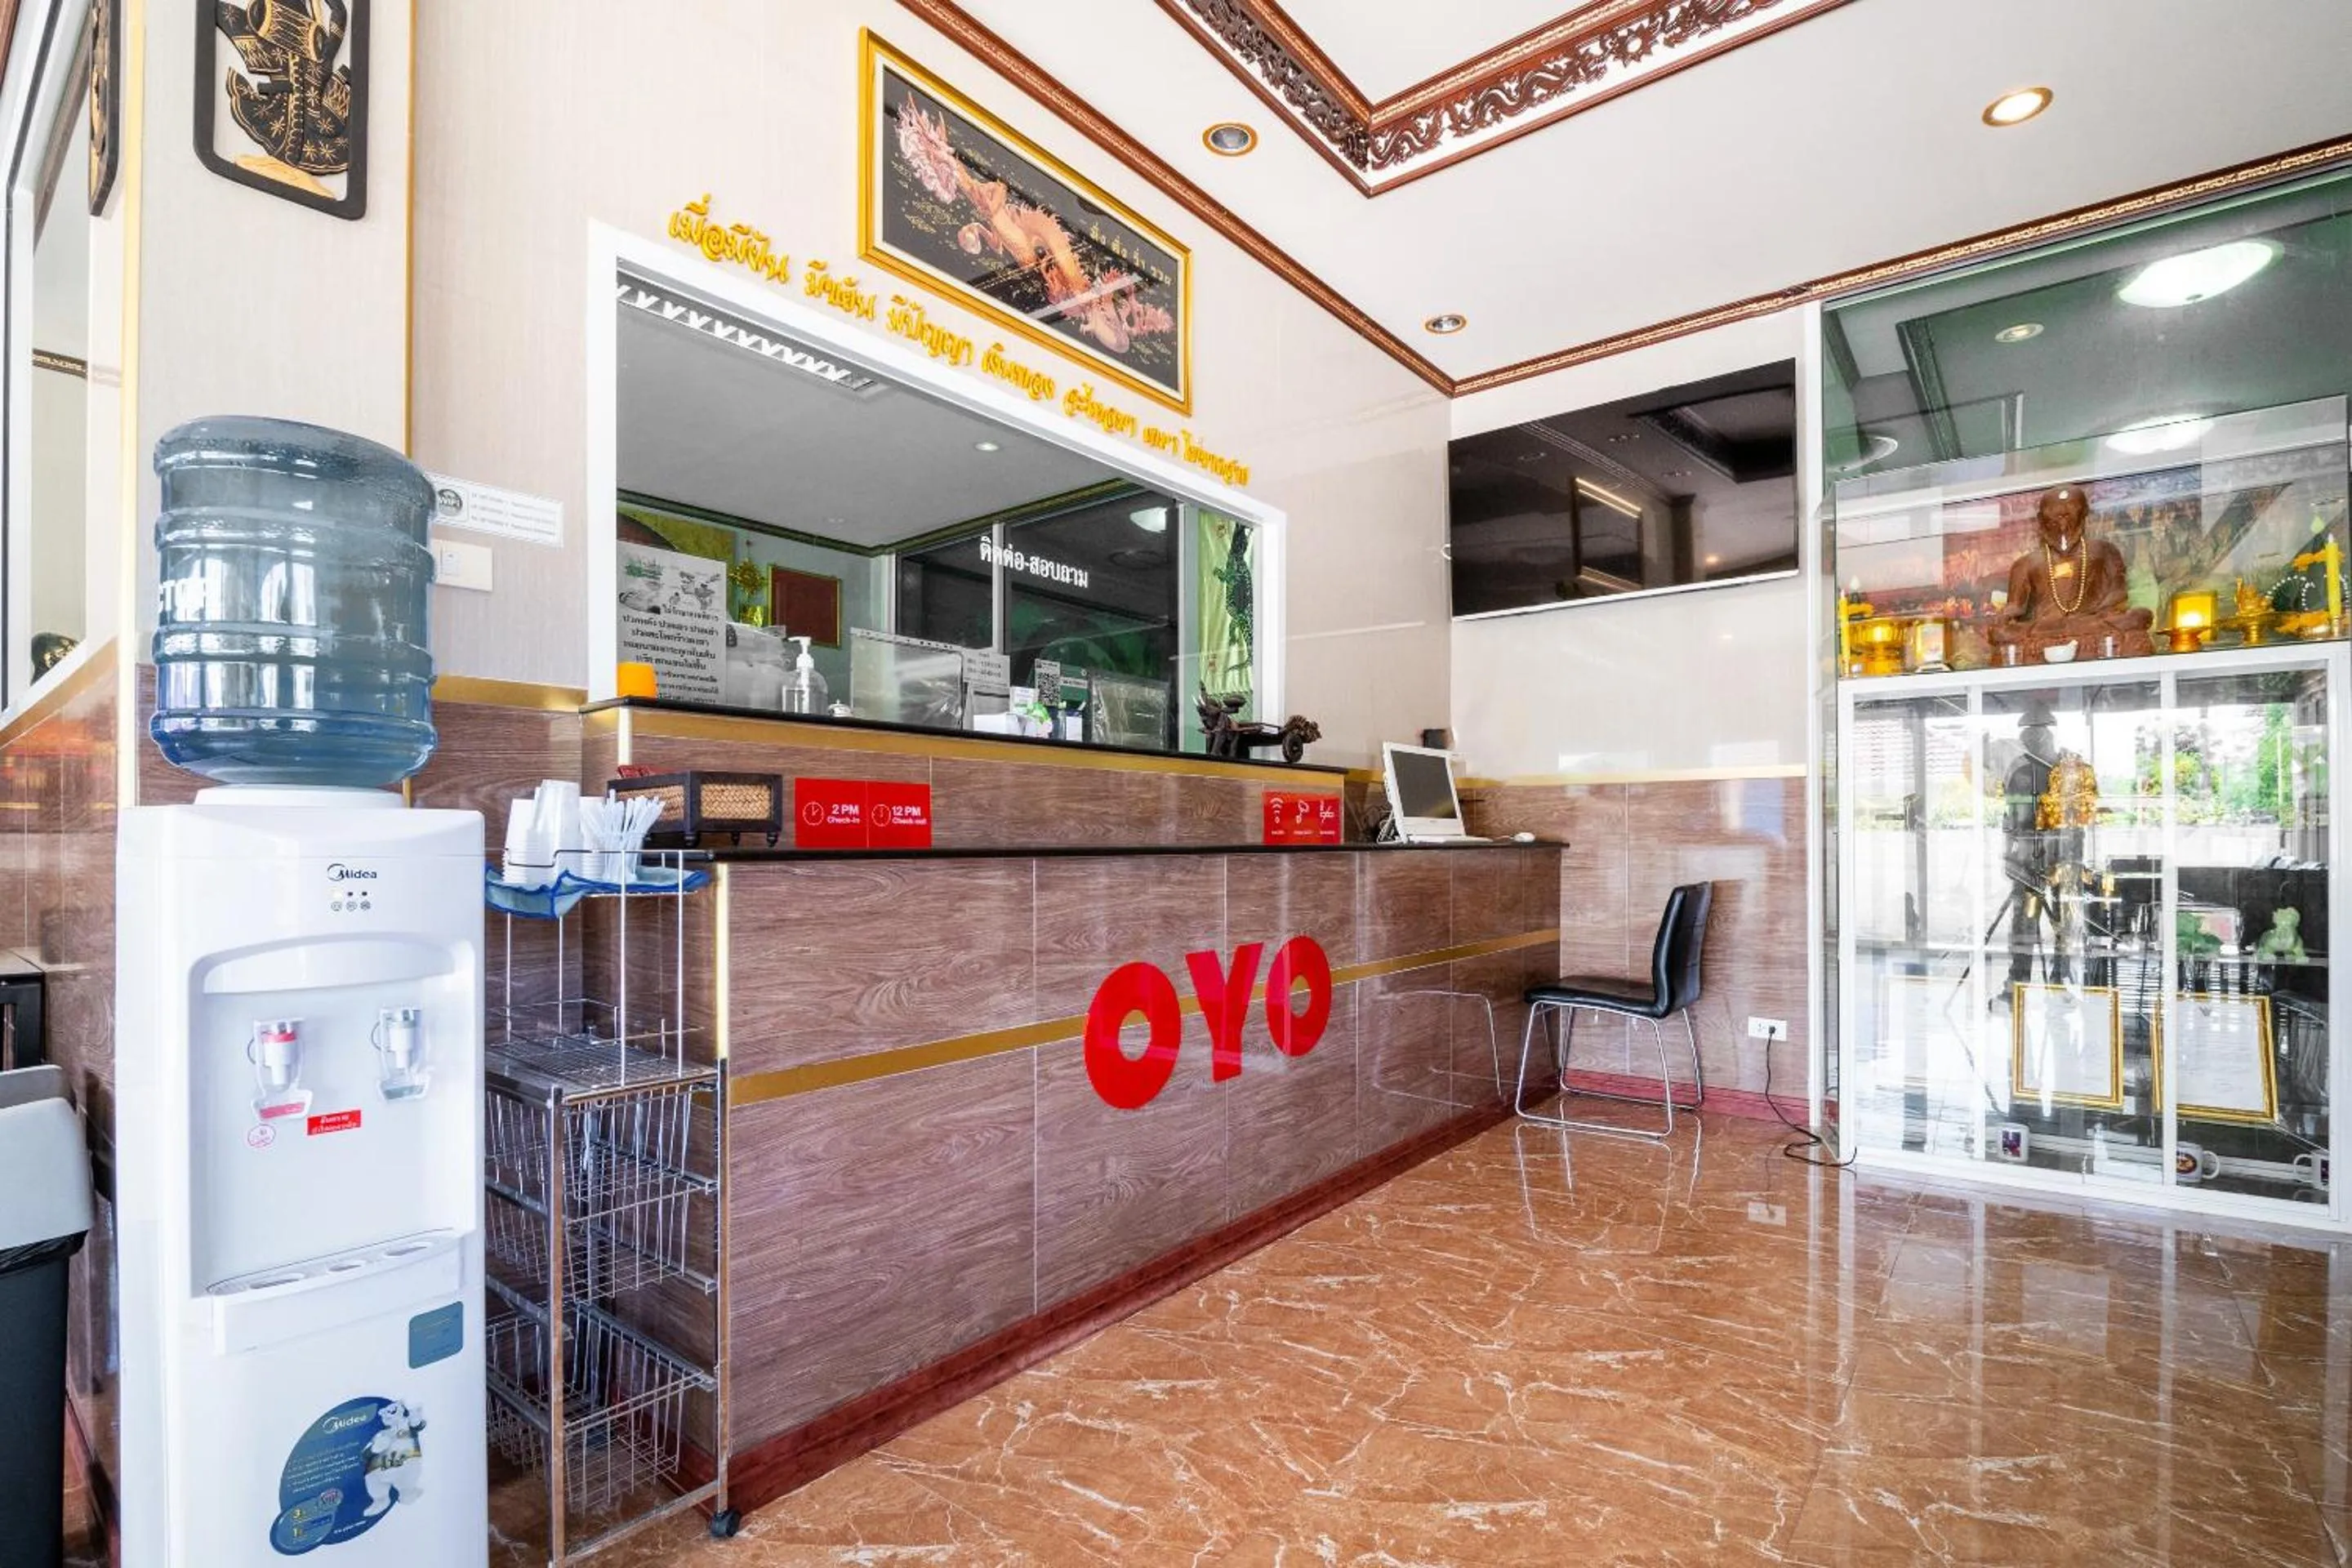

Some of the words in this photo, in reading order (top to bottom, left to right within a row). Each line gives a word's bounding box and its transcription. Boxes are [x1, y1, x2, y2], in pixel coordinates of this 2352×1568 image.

[980, 536, 1089, 588] ติดต่อ-สอบถาม
[831, 804, 840, 815] 2
[841, 804, 858, 815] PM
[891, 805, 903, 816] 12
[904, 806, 921, 816] PM
[330, 866, 377, 880] Midea
[1084, 935, 1332, 1111] OYO
[323, 1414, 367, 1433] Midea
